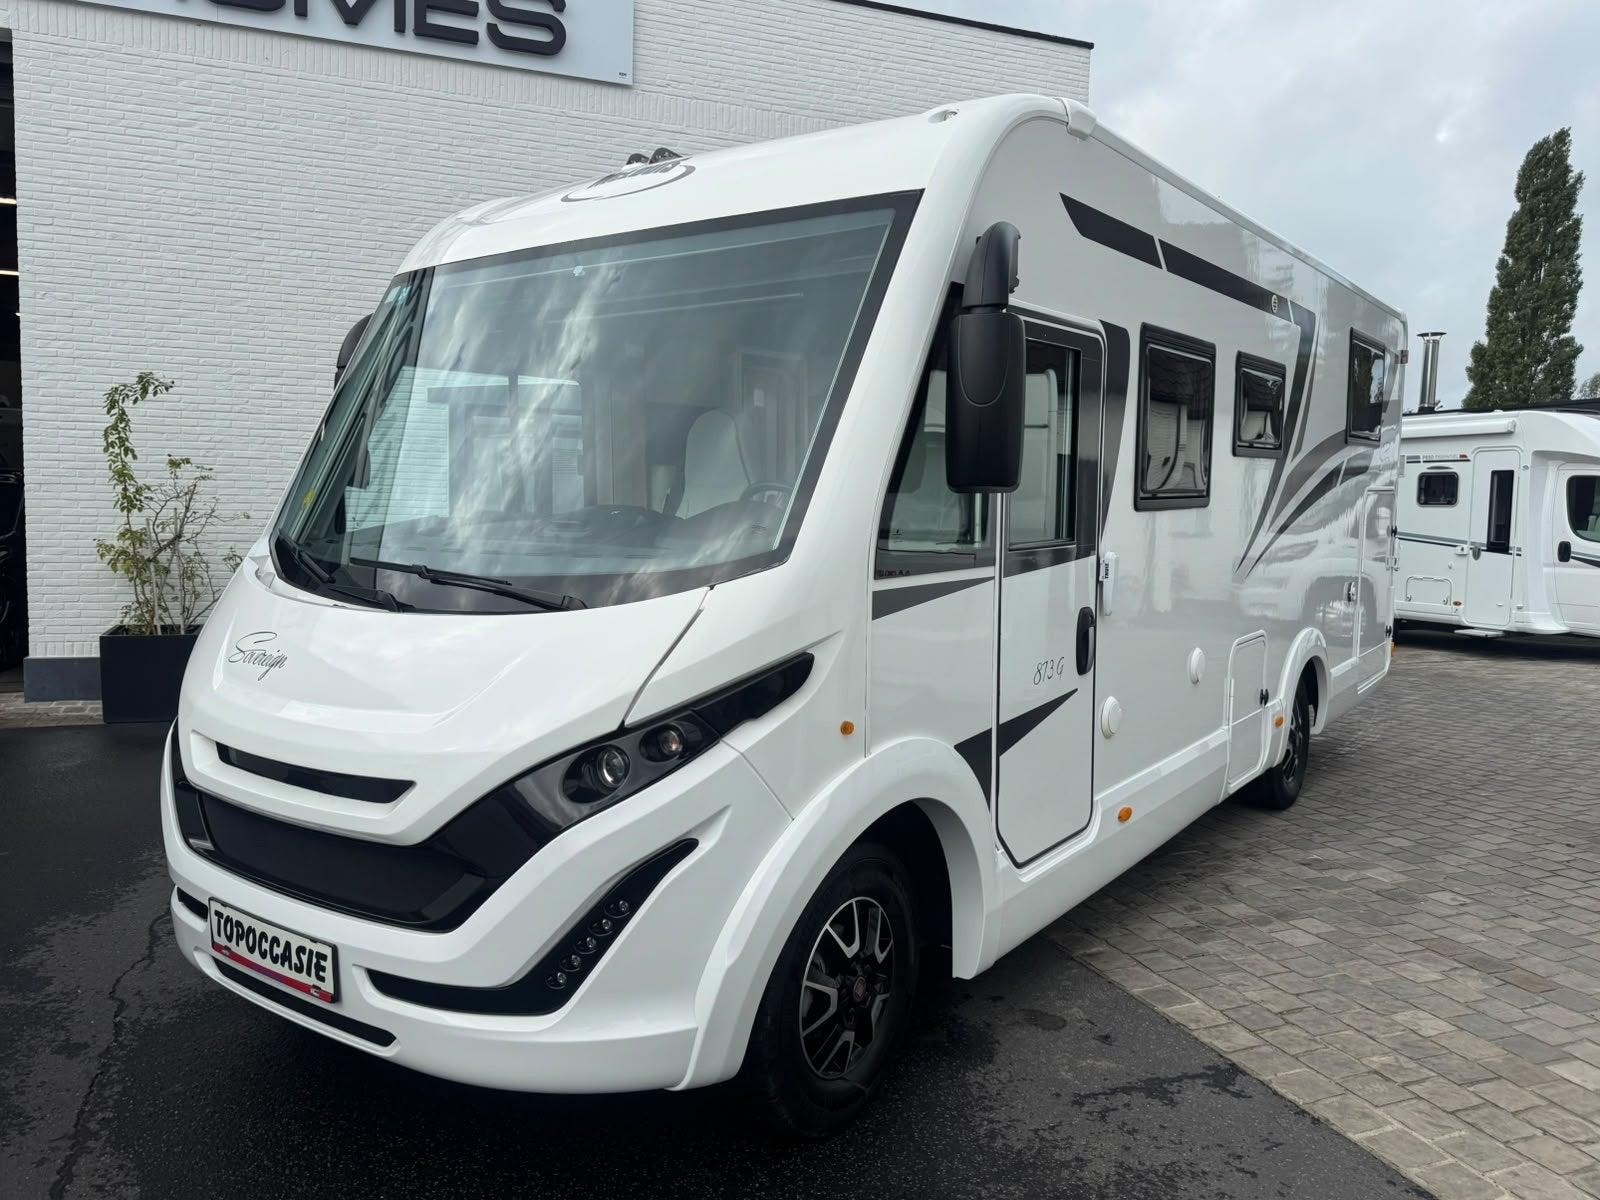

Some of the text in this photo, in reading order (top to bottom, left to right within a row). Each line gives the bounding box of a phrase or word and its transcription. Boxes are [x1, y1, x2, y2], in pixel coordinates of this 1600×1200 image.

[228, 631, 288, 681] Sovereign
[1033, 659, 1054, 685] 873
[214, 909, 328, 983] TOPOCCASIE
